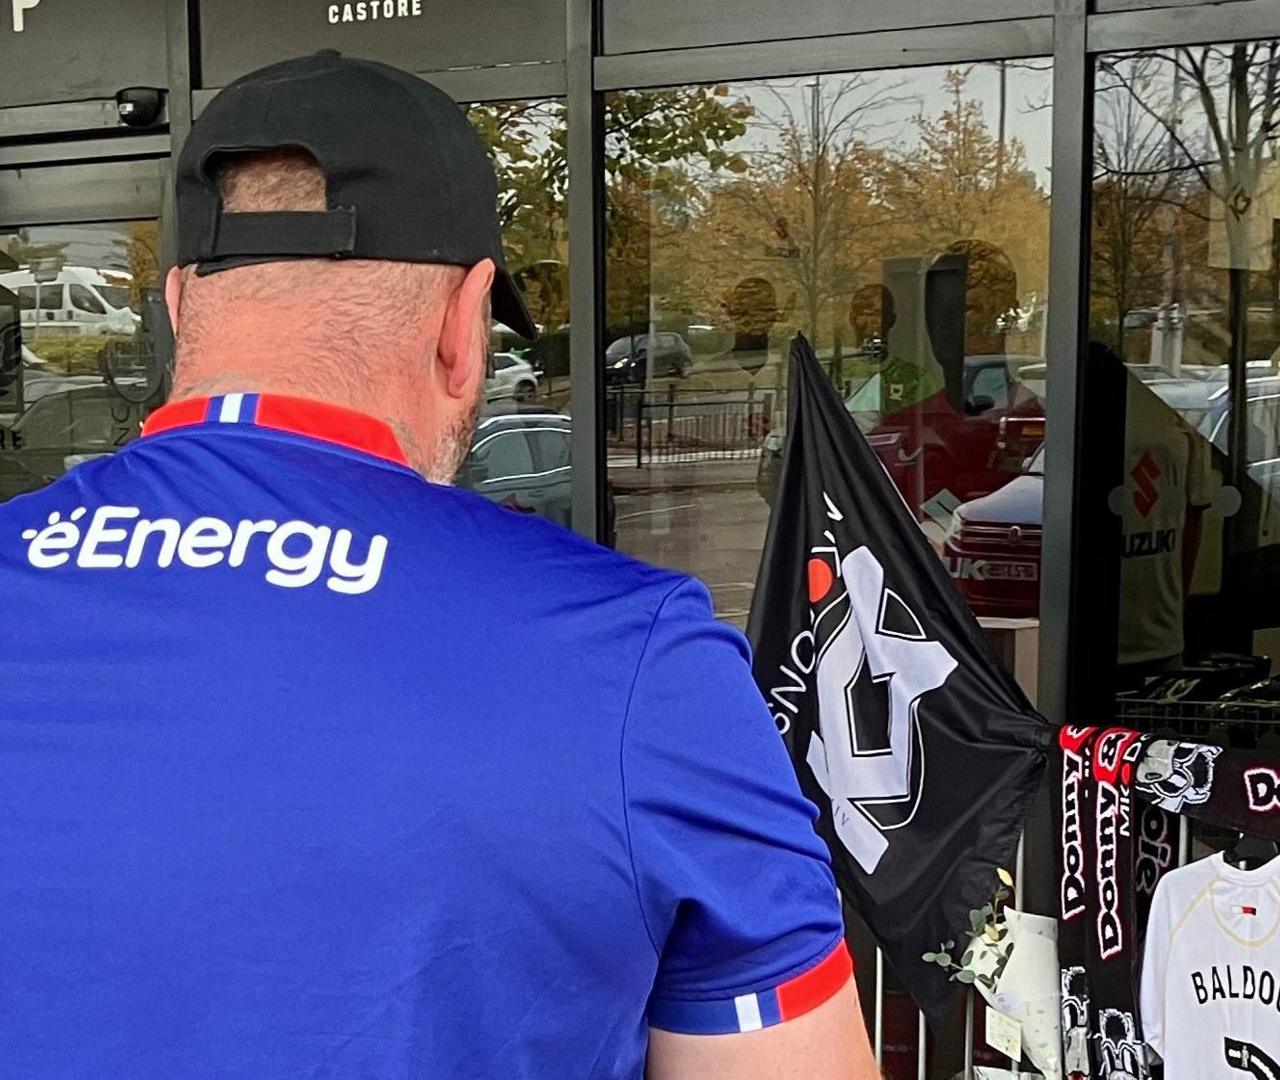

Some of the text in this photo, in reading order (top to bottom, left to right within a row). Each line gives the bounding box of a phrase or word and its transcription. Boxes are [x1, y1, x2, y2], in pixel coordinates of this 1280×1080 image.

[328, 0, 422, 24] CASTORE
[1121, 528, 1176, 560] UZUKI
[1096, 780, 1123, 960] Donny
